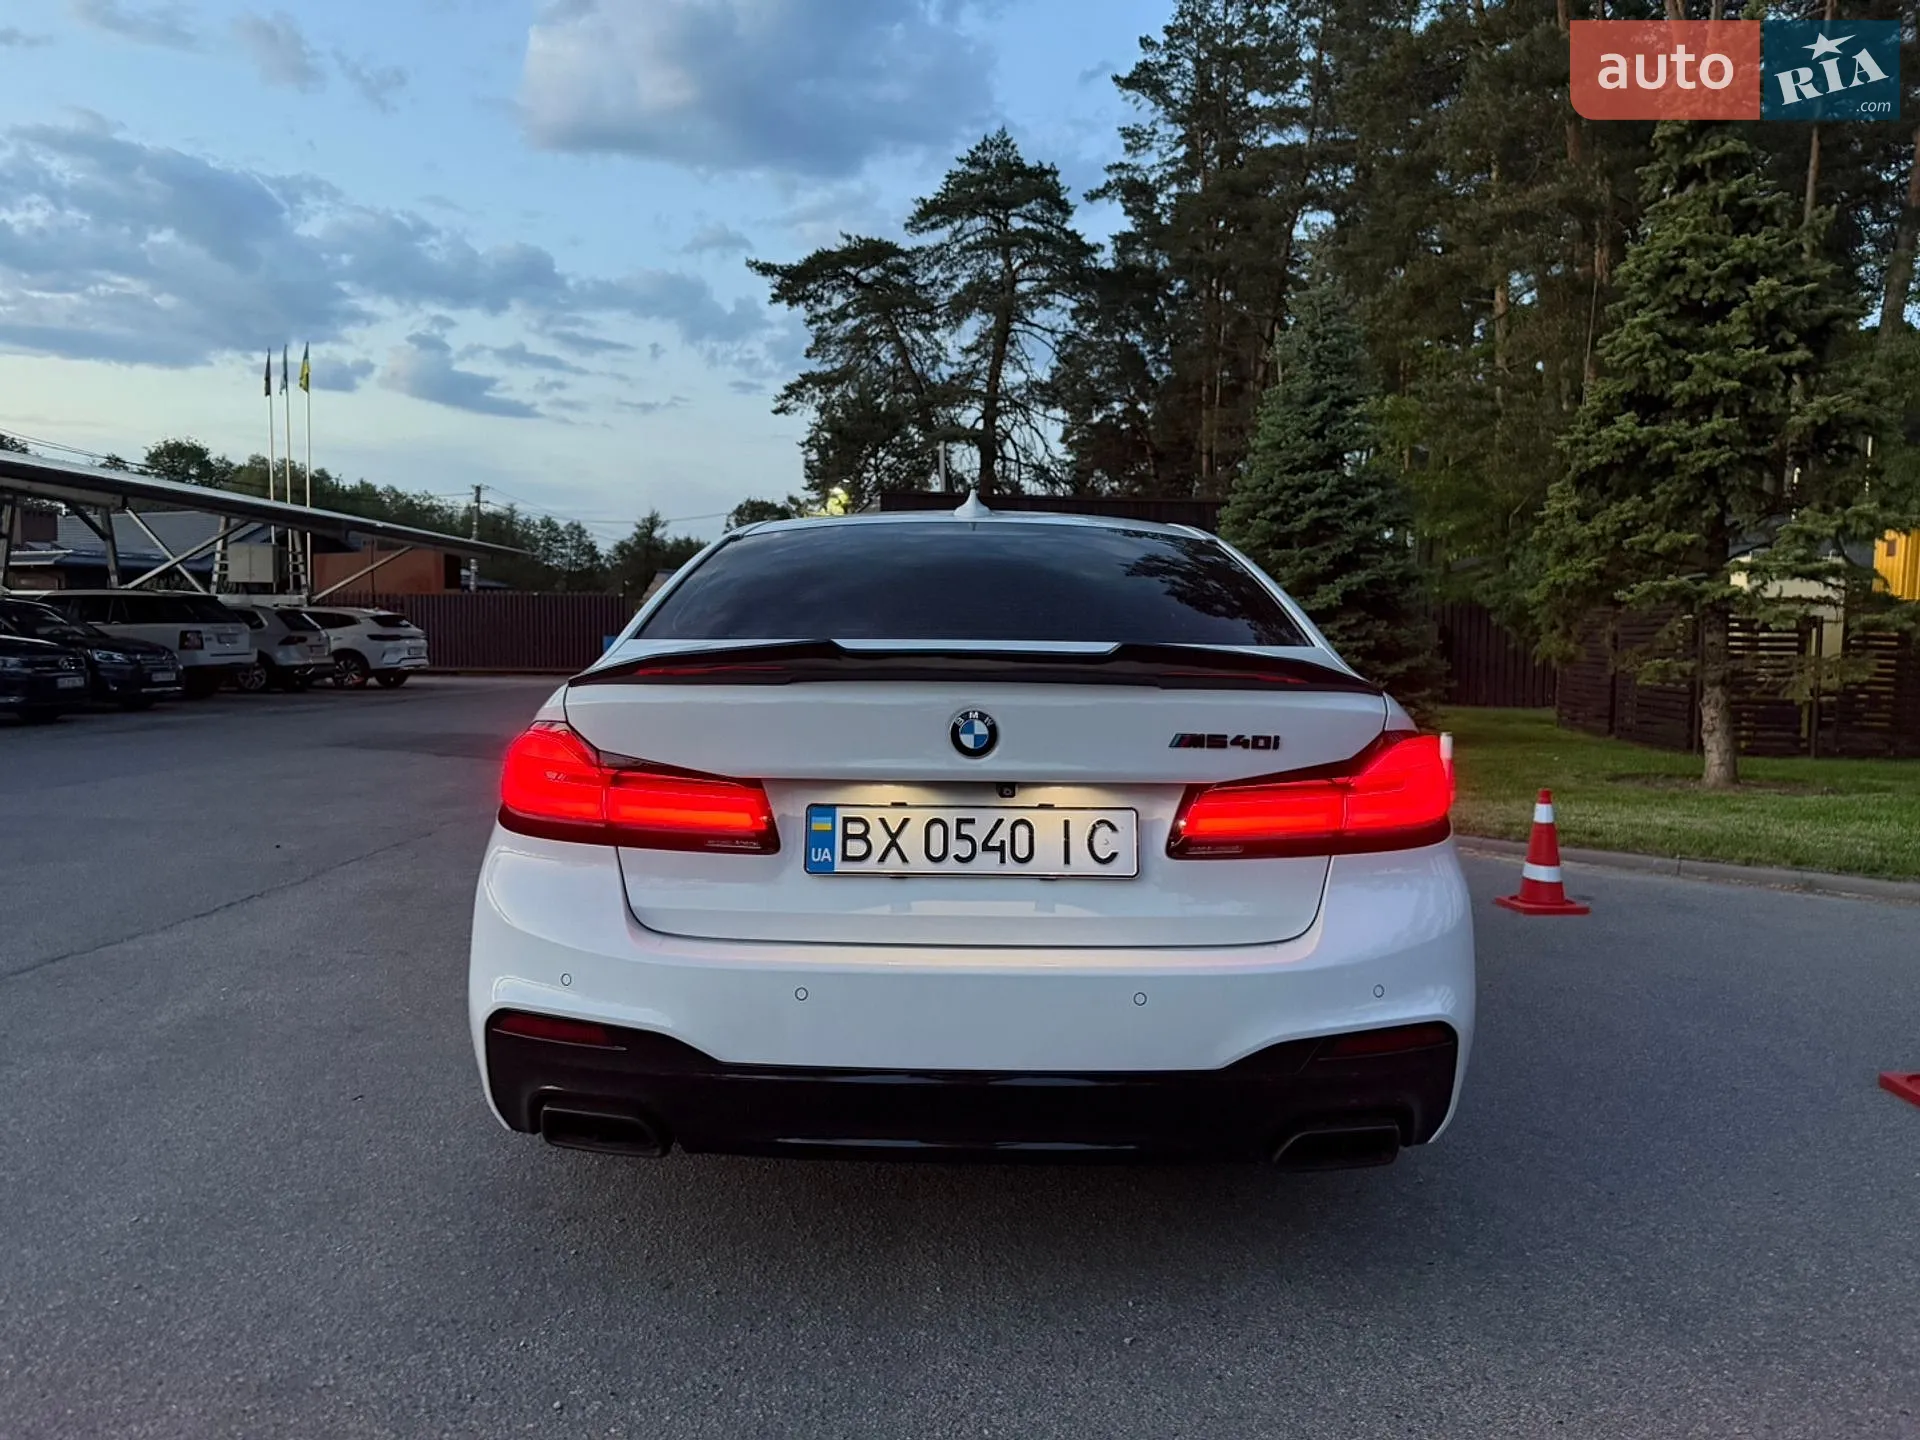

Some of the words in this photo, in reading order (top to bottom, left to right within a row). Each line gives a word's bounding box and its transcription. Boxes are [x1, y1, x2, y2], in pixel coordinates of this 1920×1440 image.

[955, 711, 994, 727] BMW
[841, 816, 911, 864] BX
[924, 817, 1035, 865] 0540
[1063, 818, 1119, 865] IC
[811, 848, 832, 862] UA
